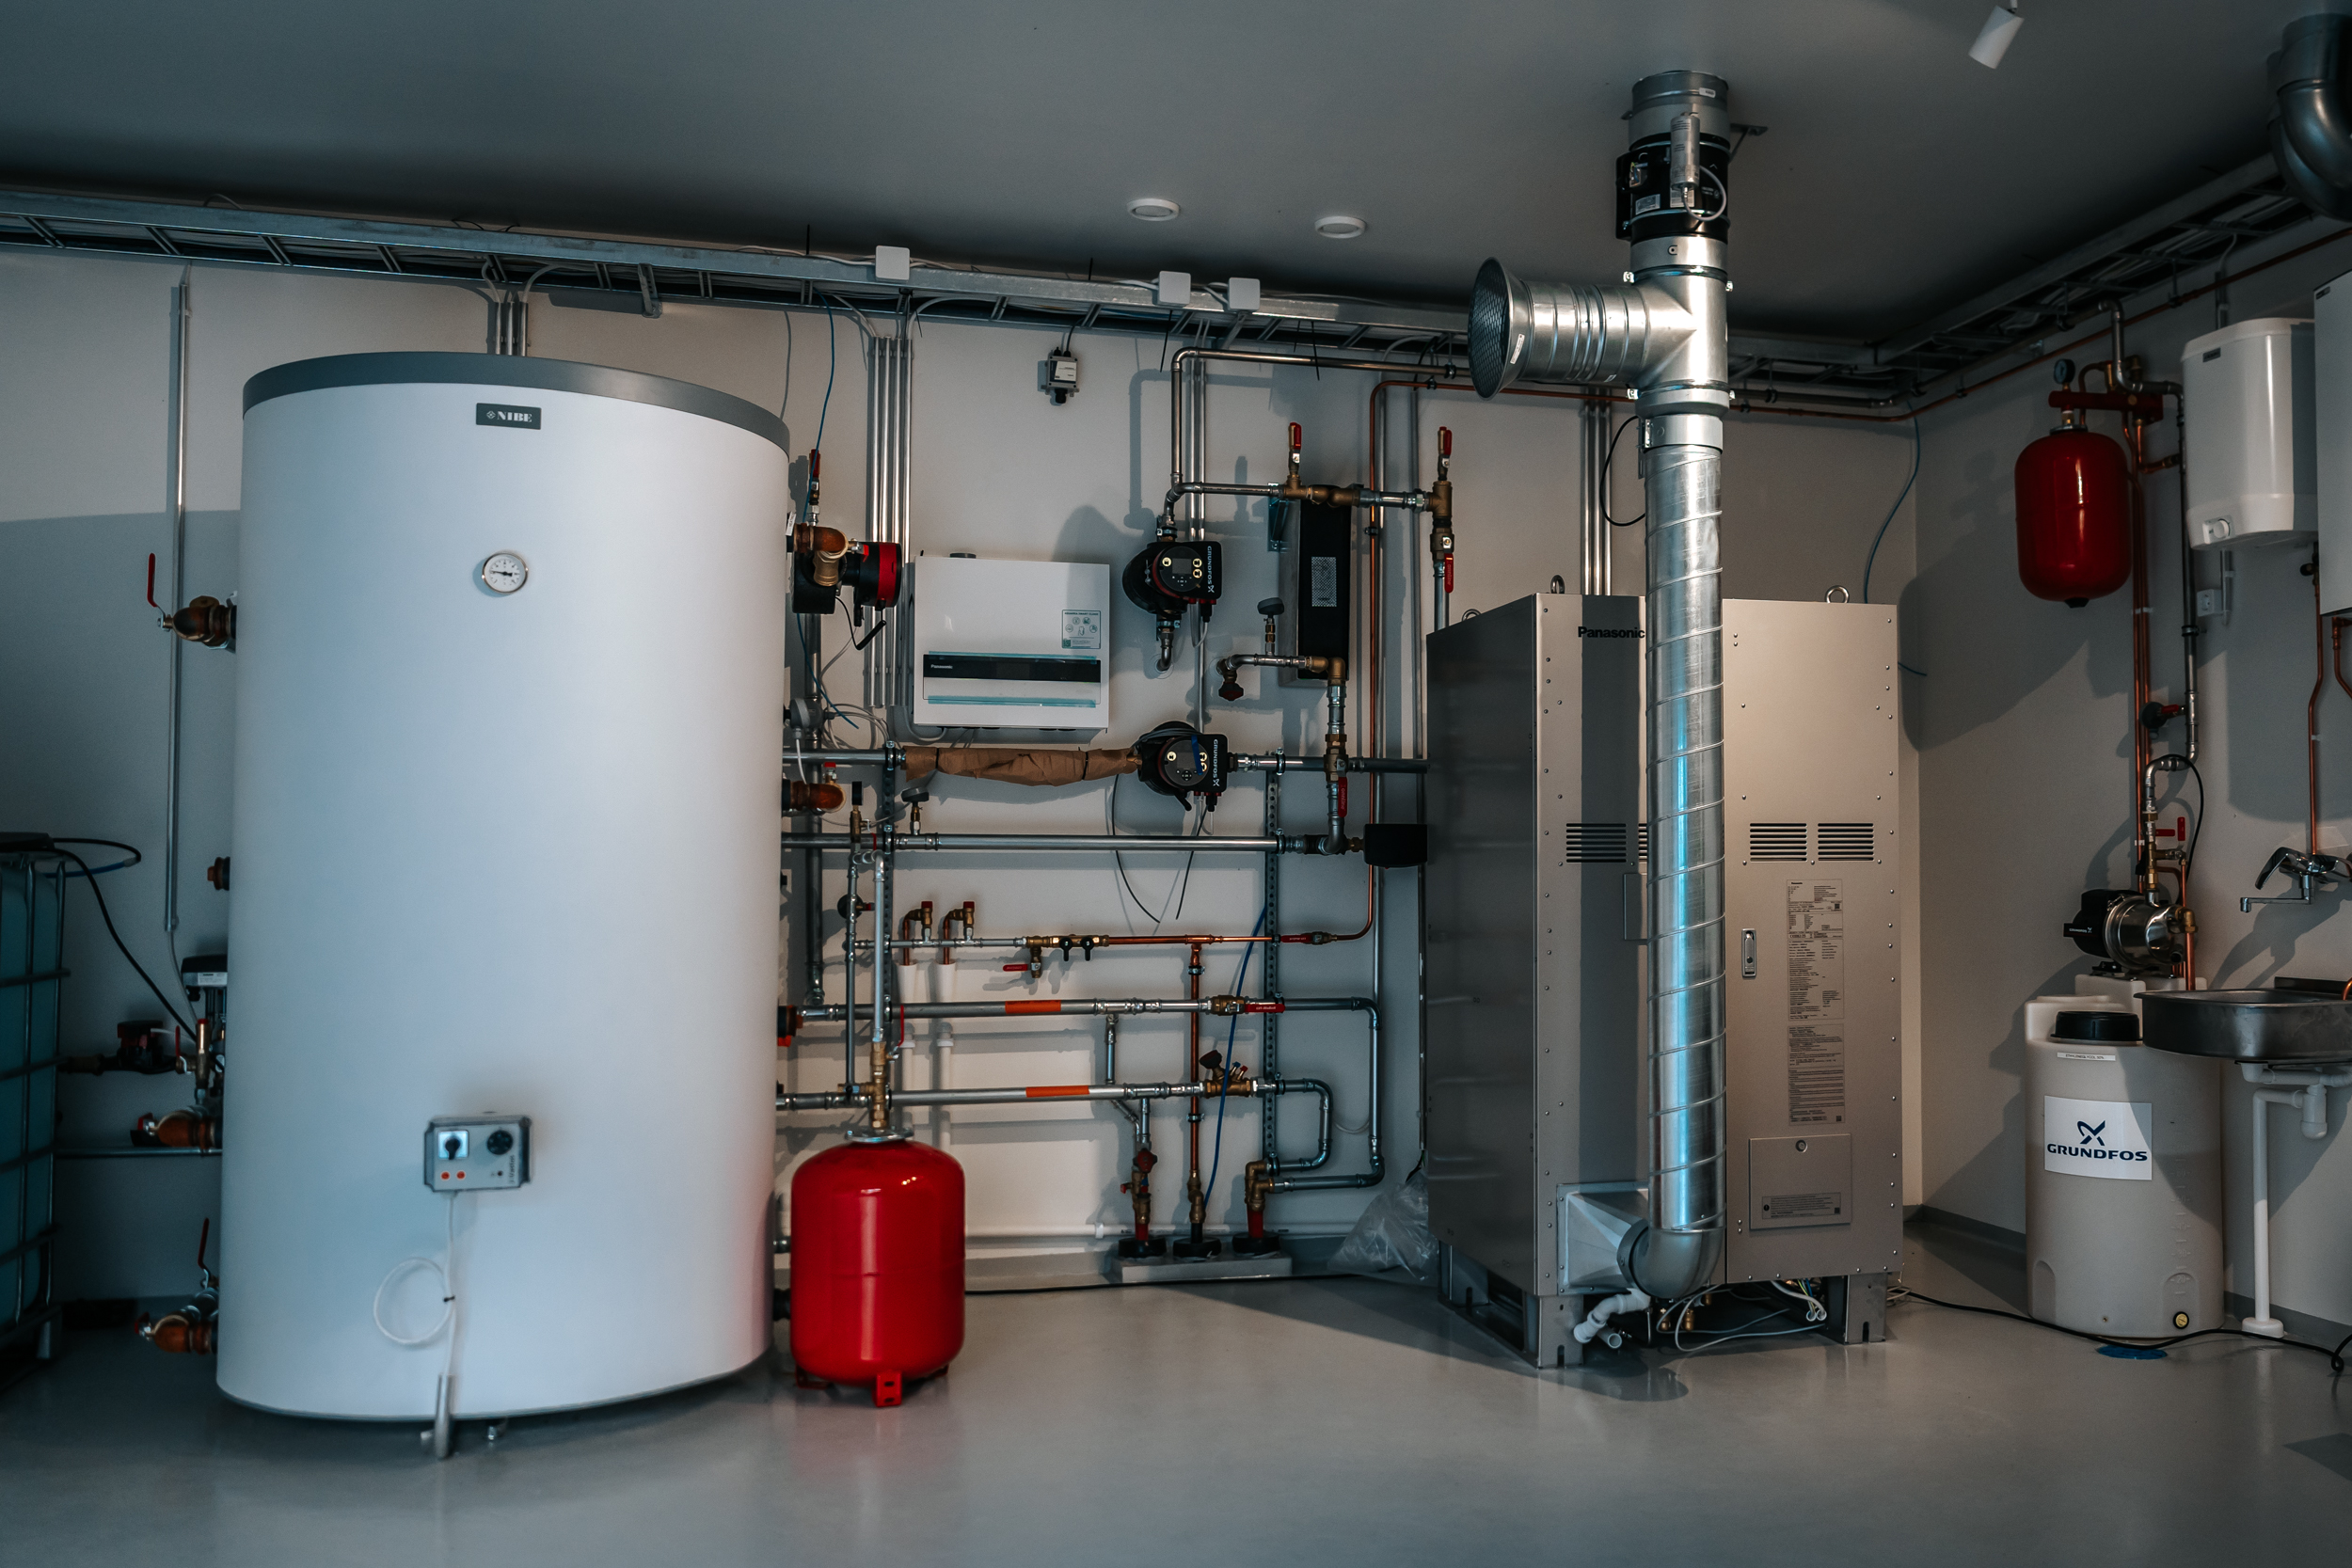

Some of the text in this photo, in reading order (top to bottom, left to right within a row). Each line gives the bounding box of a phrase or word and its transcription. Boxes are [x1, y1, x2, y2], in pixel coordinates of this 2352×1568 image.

[497, 411, 532, 422] NIBE
[1578, 626, 1645, 639] Panasonic
[2046, 1143, 2149, 1162] GRUNDFOS
